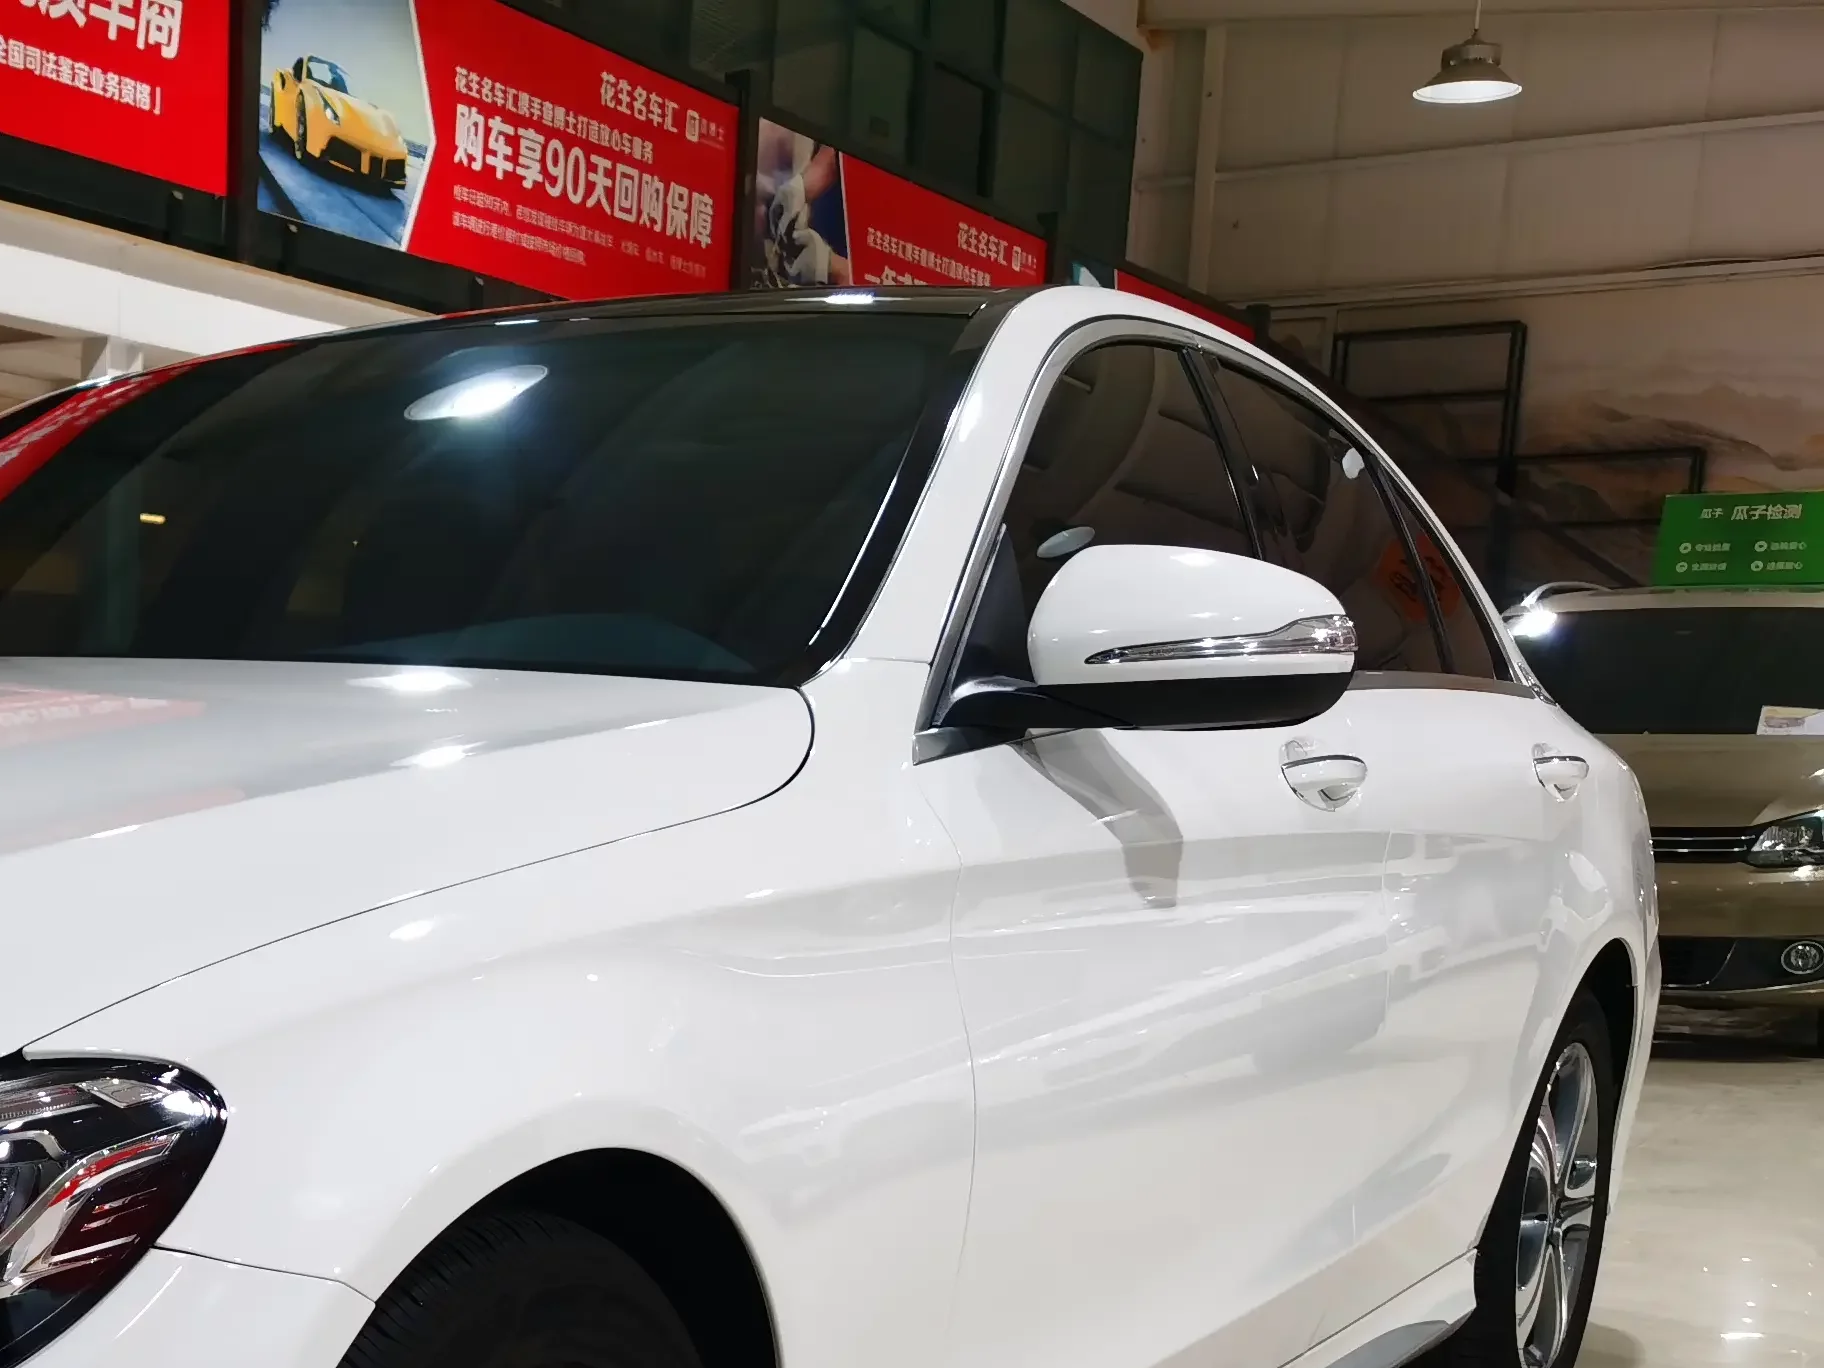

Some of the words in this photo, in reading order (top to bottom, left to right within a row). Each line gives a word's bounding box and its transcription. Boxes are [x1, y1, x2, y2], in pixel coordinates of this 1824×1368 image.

[600, 71, 679, 133] 花生名车汇
[454, 103, 714, 249] 购车享90天回购保障
[957, 222, 1008, 266] 花生名车汇
[1731, 504, 1803, 521] 瓜子检测
